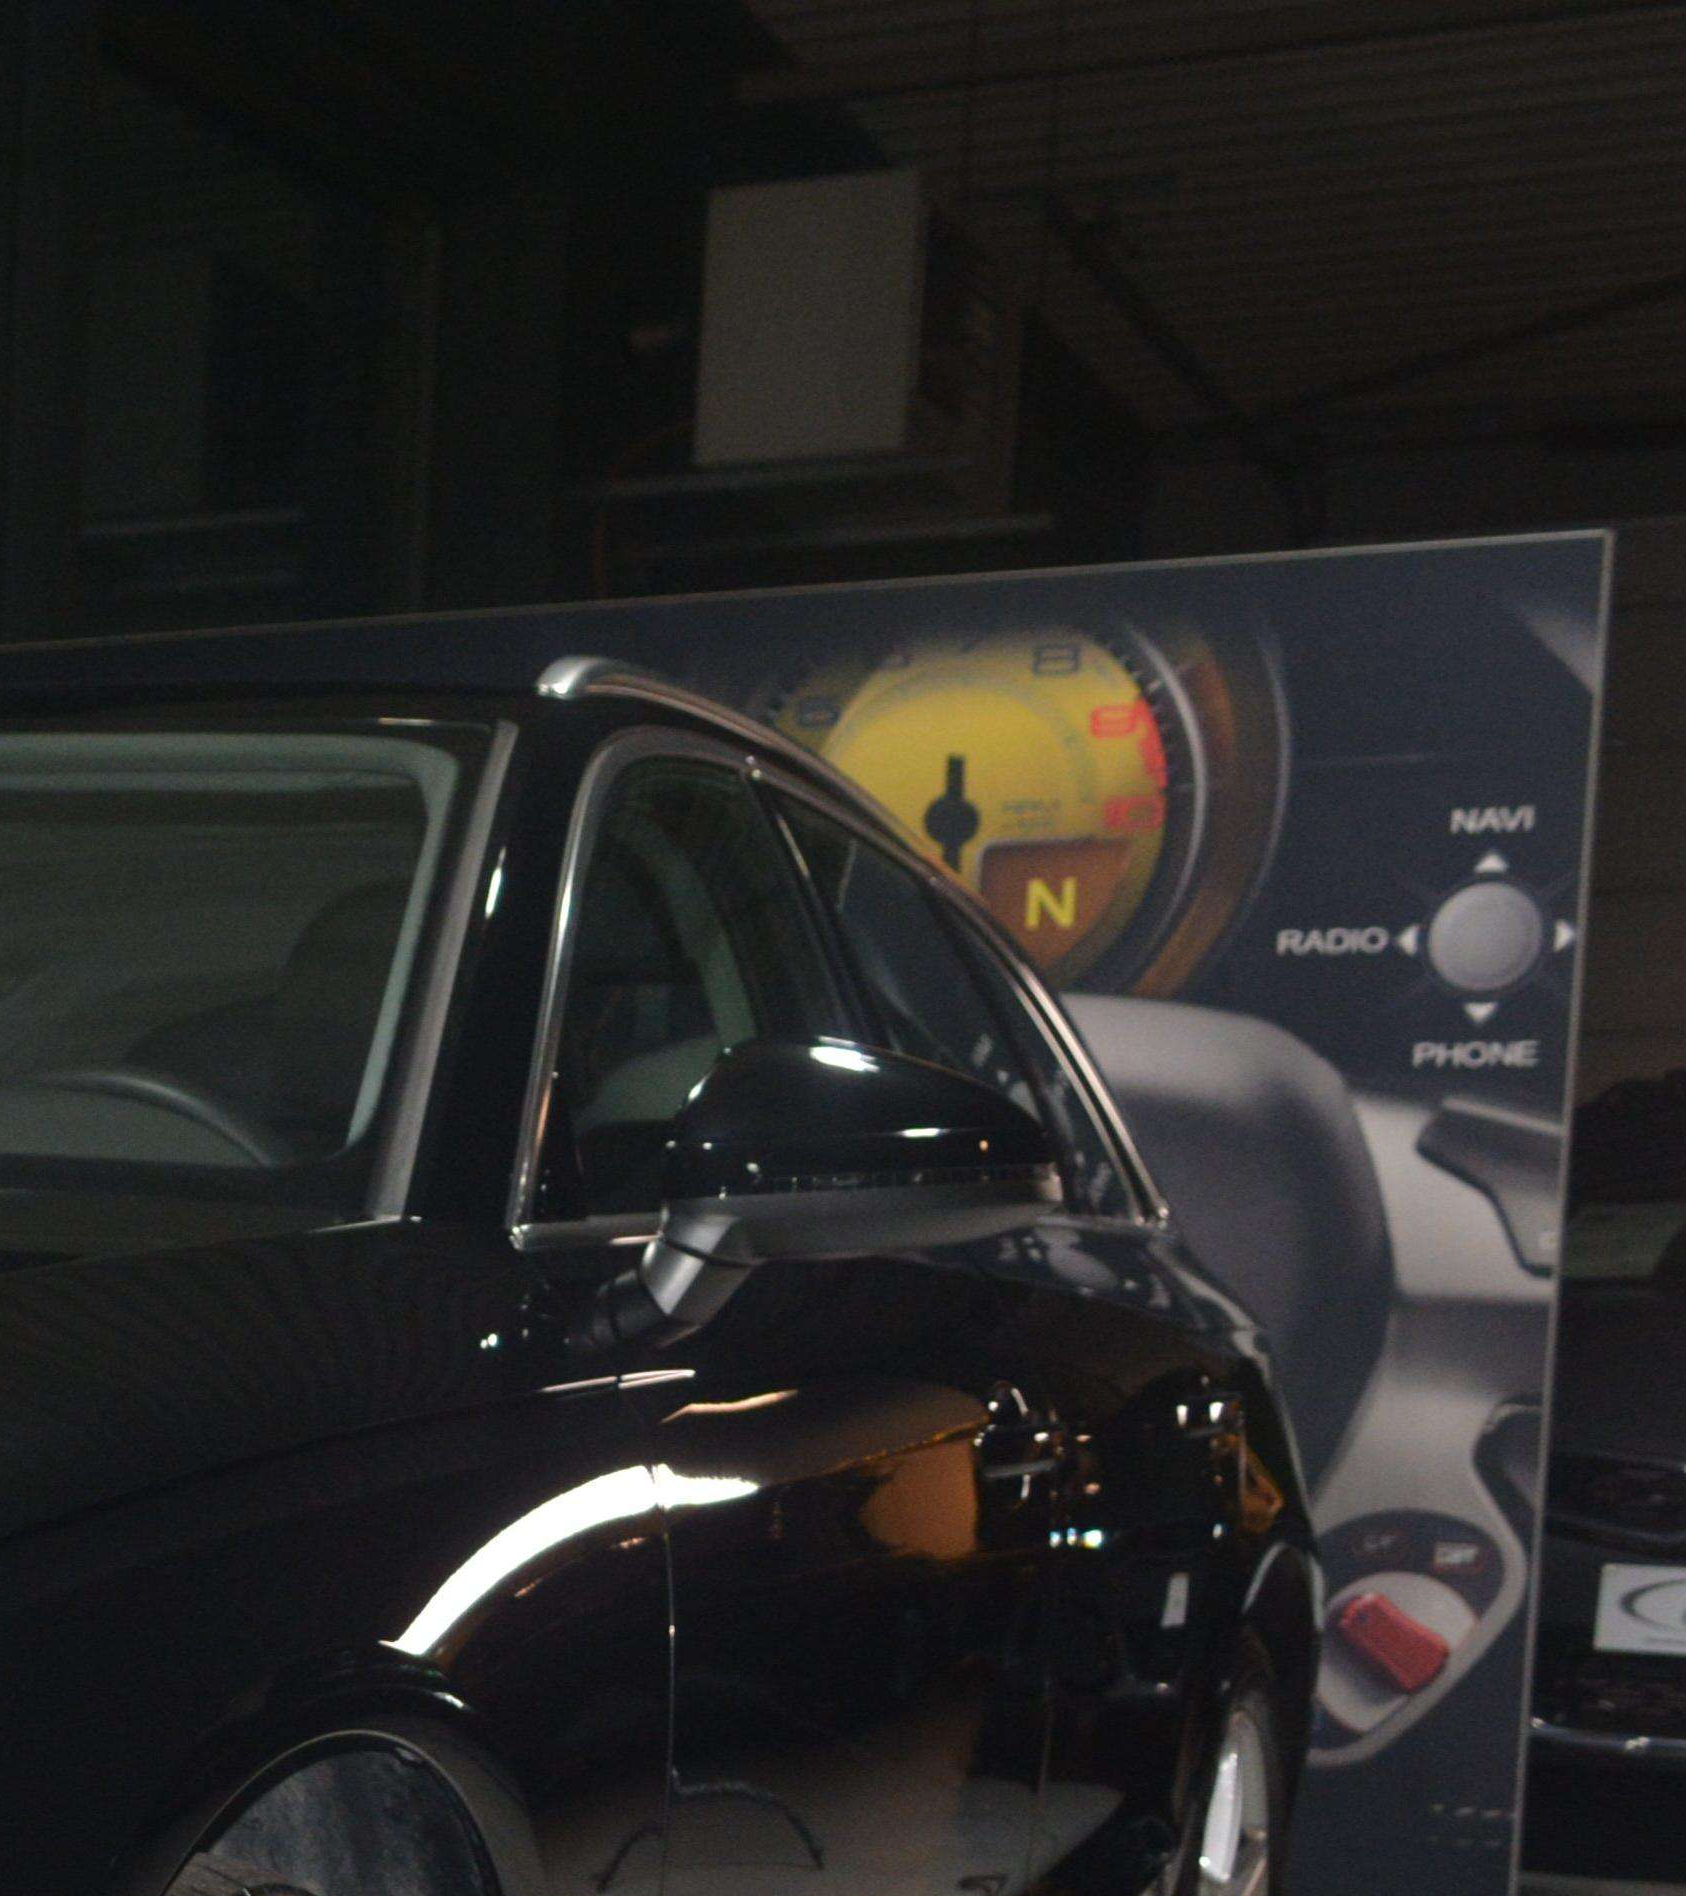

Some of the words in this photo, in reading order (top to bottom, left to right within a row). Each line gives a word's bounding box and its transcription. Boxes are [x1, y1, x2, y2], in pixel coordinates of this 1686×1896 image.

[1450, 805, 1536, 834] NAVI
[1027, 876, 1077, 931] N
[1277, 926, 1389, 956] RADIO
[1411, 1039, 1540, 1068] PHONE
